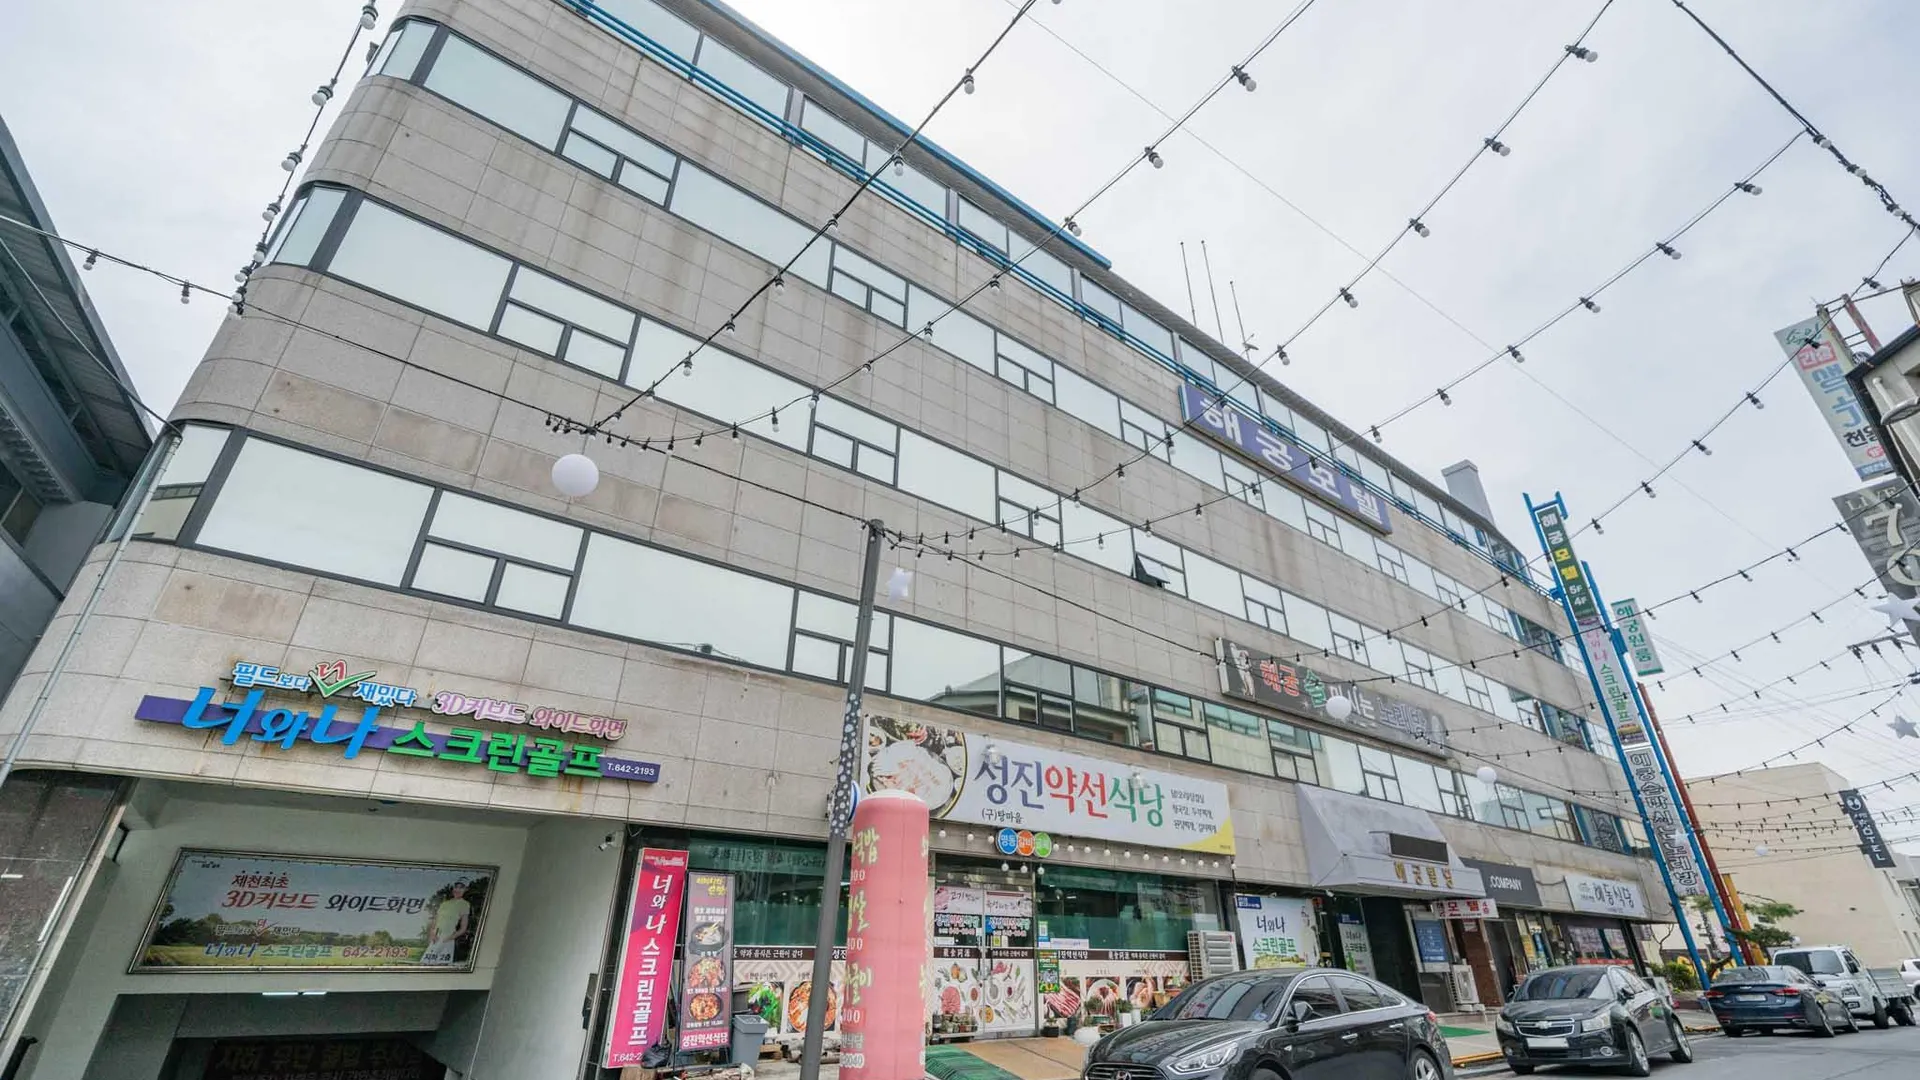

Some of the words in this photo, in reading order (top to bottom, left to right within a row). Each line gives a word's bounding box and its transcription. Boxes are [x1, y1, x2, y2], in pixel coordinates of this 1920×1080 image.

[233, 662, 312, 692] 필드보다
[353, 681, 417, 708] 재밌다
[182, 686, 379, 759] 너와나
[387, 720, 605, 778] 스크린골프
[606, 762, 656, 777] T.642-2193
[432, 689, 527, 724] 3D커브드
[531, 706, 628, 741] 와이드화면
[974, 755, 1166, 828] 성진약선식당
[221, 890, 320, 910] 3D커브드
[324, 893, 425, 913] 와이드화면
[231, 873, 290, 890] 제천최초
[645, 874, 673, 935] 너와나
[1252, 937, 1297, 955] 스크린골프
[1256, 914, 1286, 933] 너와나
[343, 945, 409, 958] 642-2193
[628, 939, 661, 1046] 스크린골프
